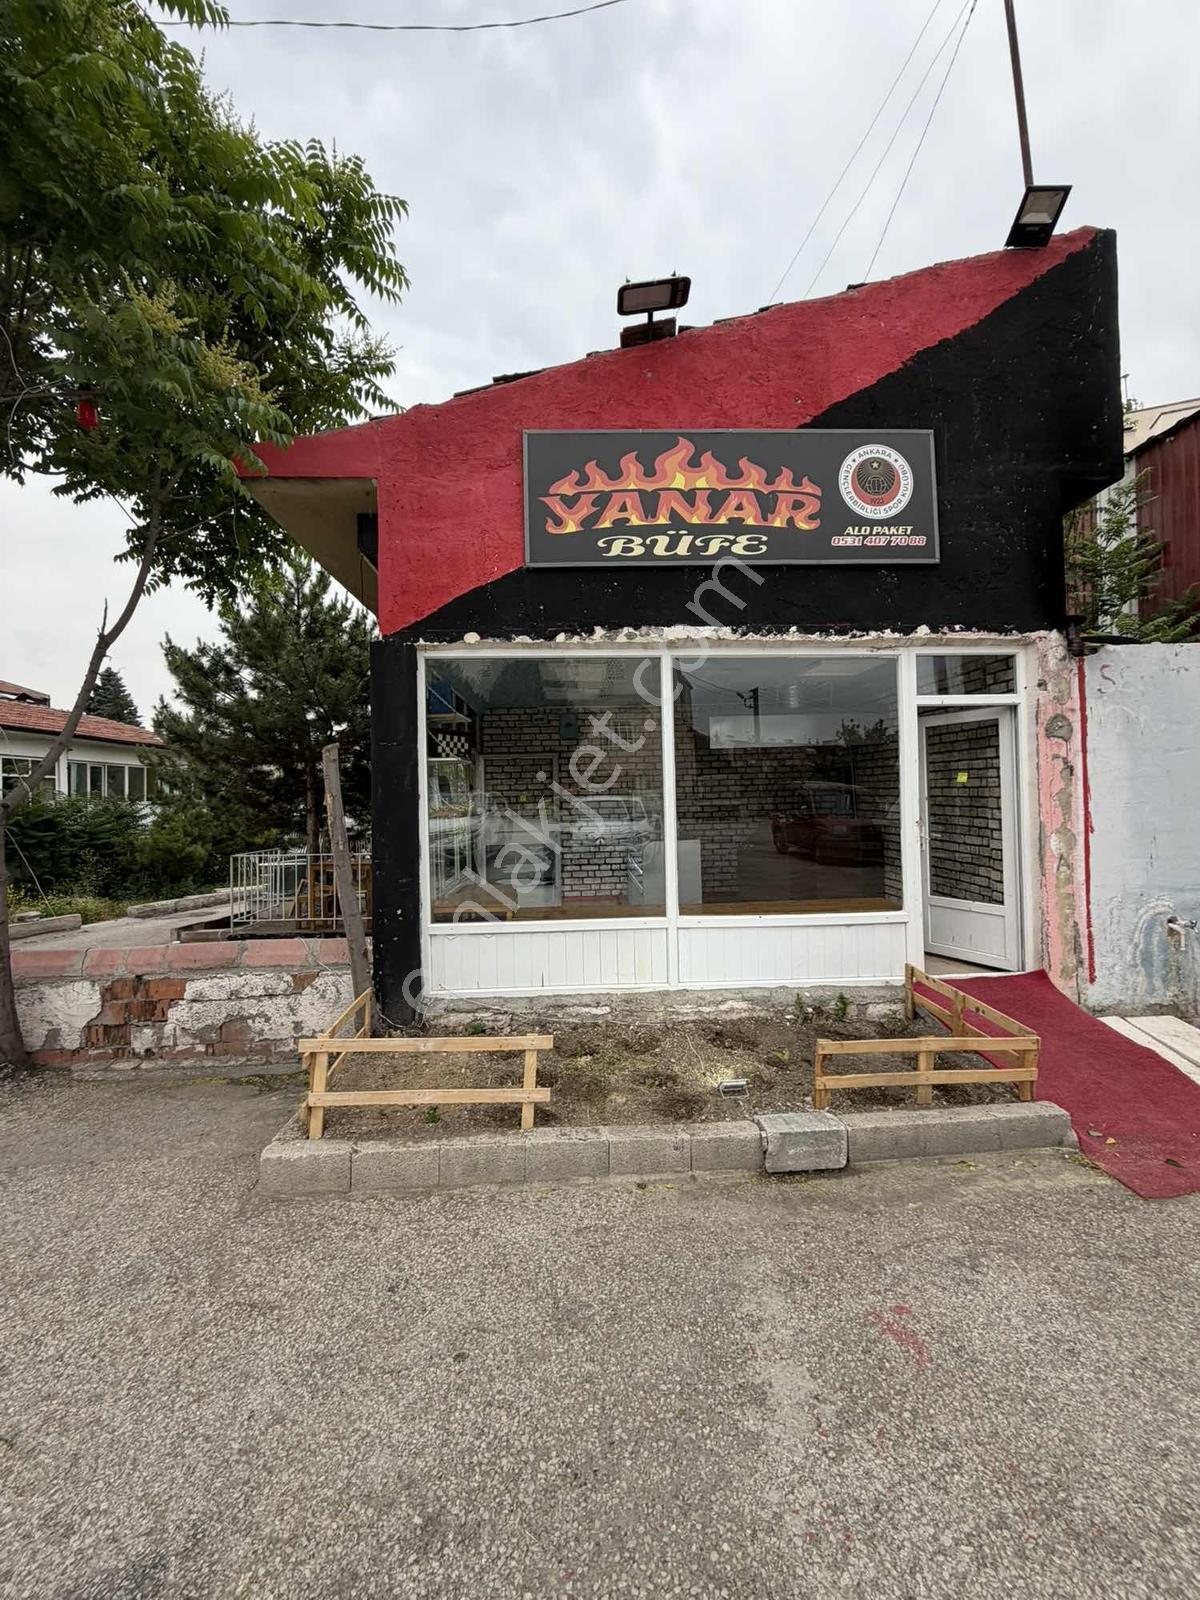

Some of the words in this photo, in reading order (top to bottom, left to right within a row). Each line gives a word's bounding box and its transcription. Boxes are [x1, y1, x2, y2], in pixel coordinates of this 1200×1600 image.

[858, 448, 892, 459] ANKARA
[538, 489, 822, 534] YANAR
[883, 498, 906, 514] SPOR
[844, 526, 870, 535] ALO
[872, 526, 913, 535] PAKET
[597, 530, 768, 557] BÜFE
[831, 536, 863, 546] 0531
[864, 536, 890, 546] 407
